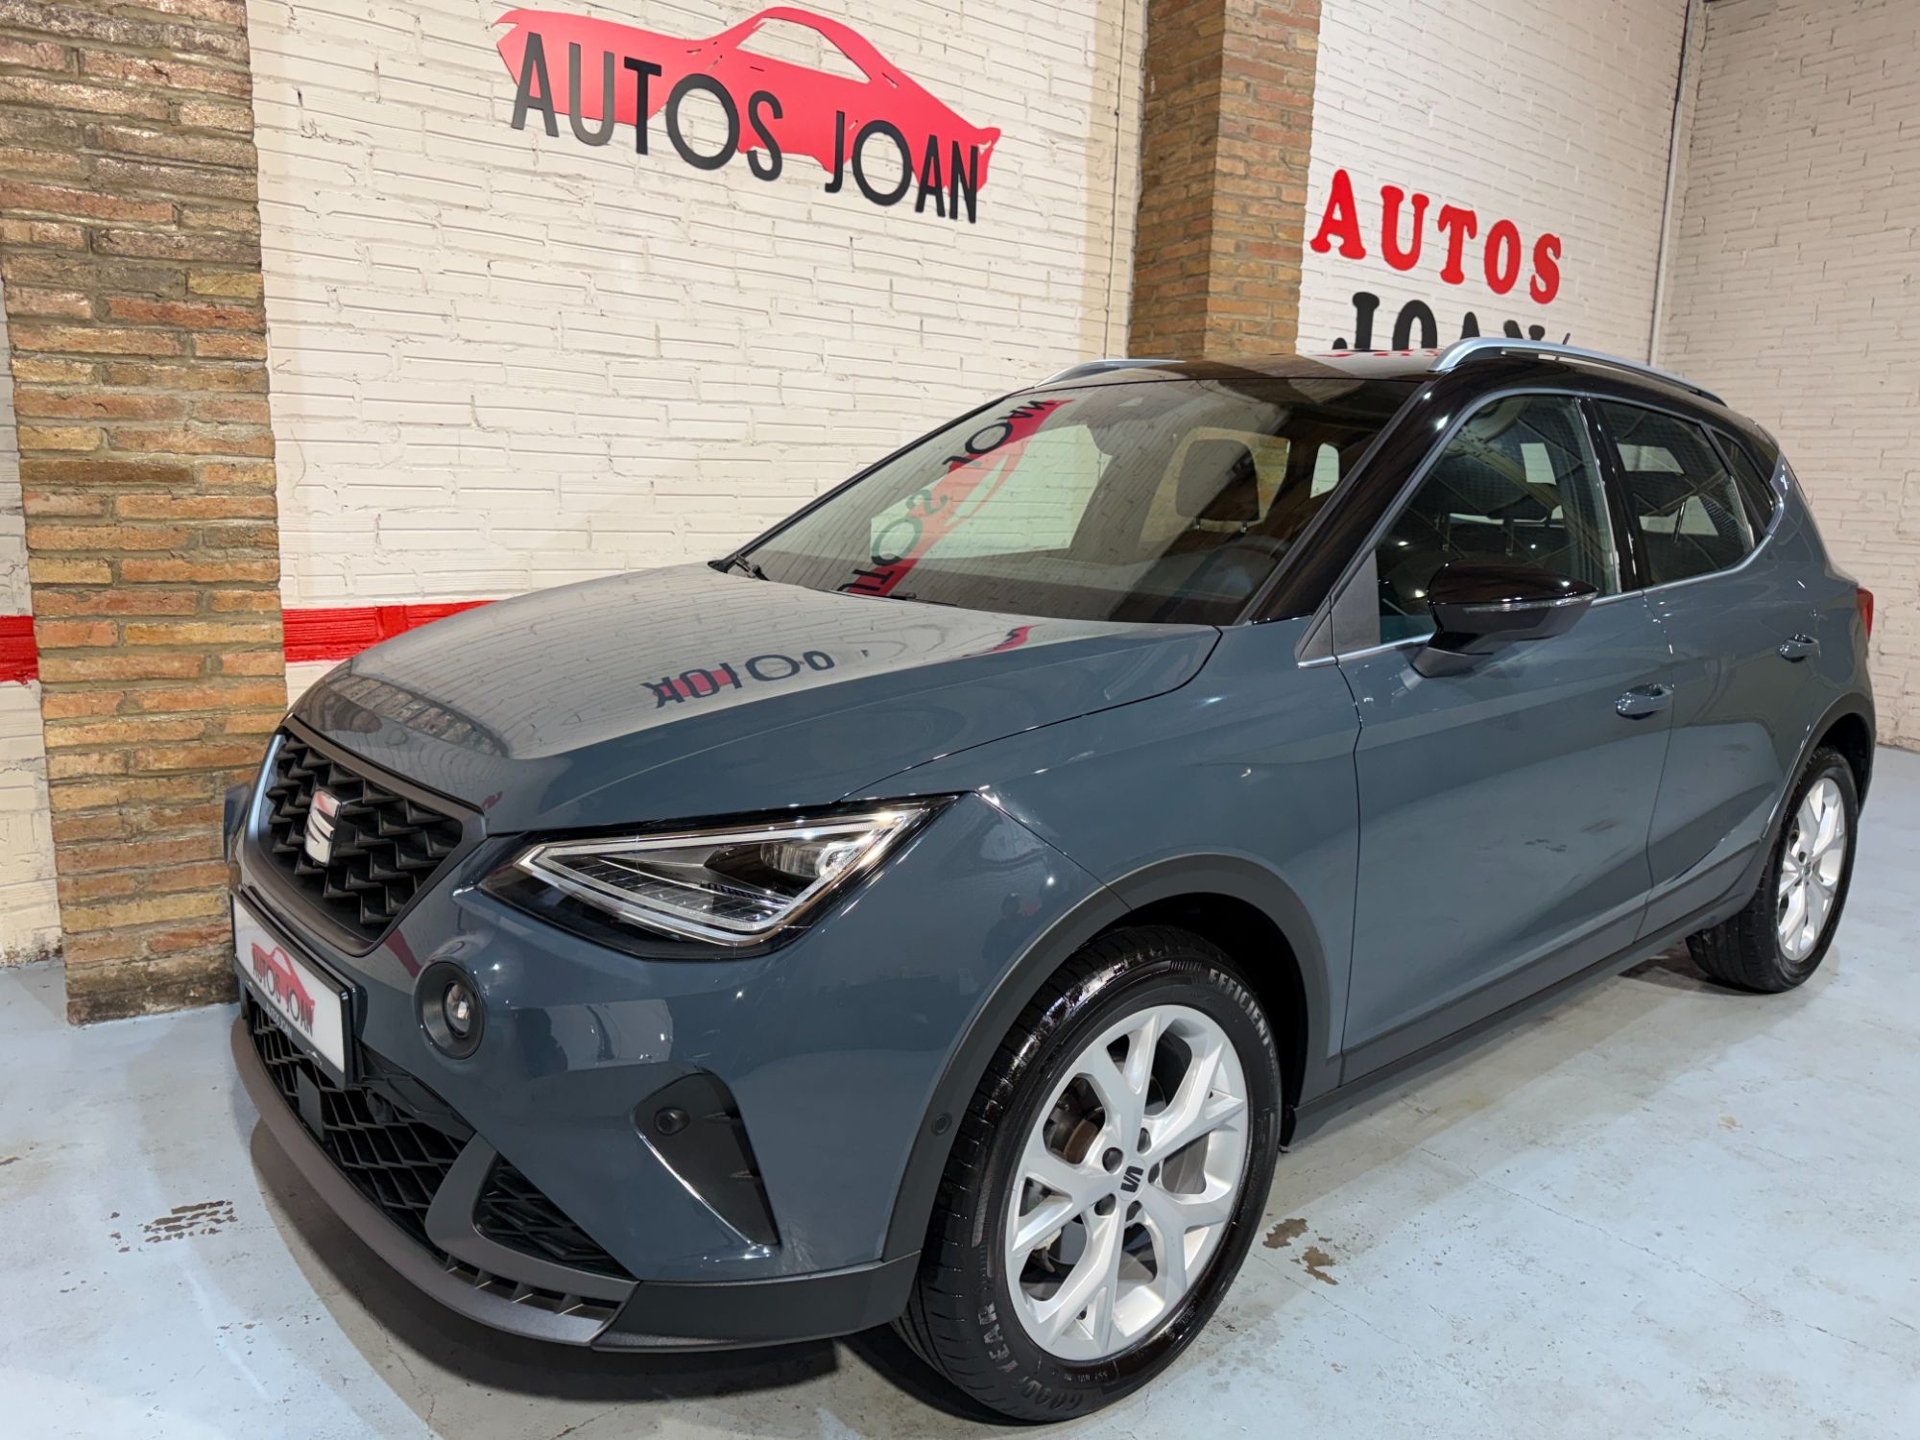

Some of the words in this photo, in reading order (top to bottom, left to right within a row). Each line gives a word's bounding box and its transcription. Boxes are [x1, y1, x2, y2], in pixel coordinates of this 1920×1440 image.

[511, 32, 783, 182] AUTOS
[824, 111, 978, 224] JOAN
[1310, 169, 1562, 305] AUTOS
[1332, 292, 1545, 351] JO
